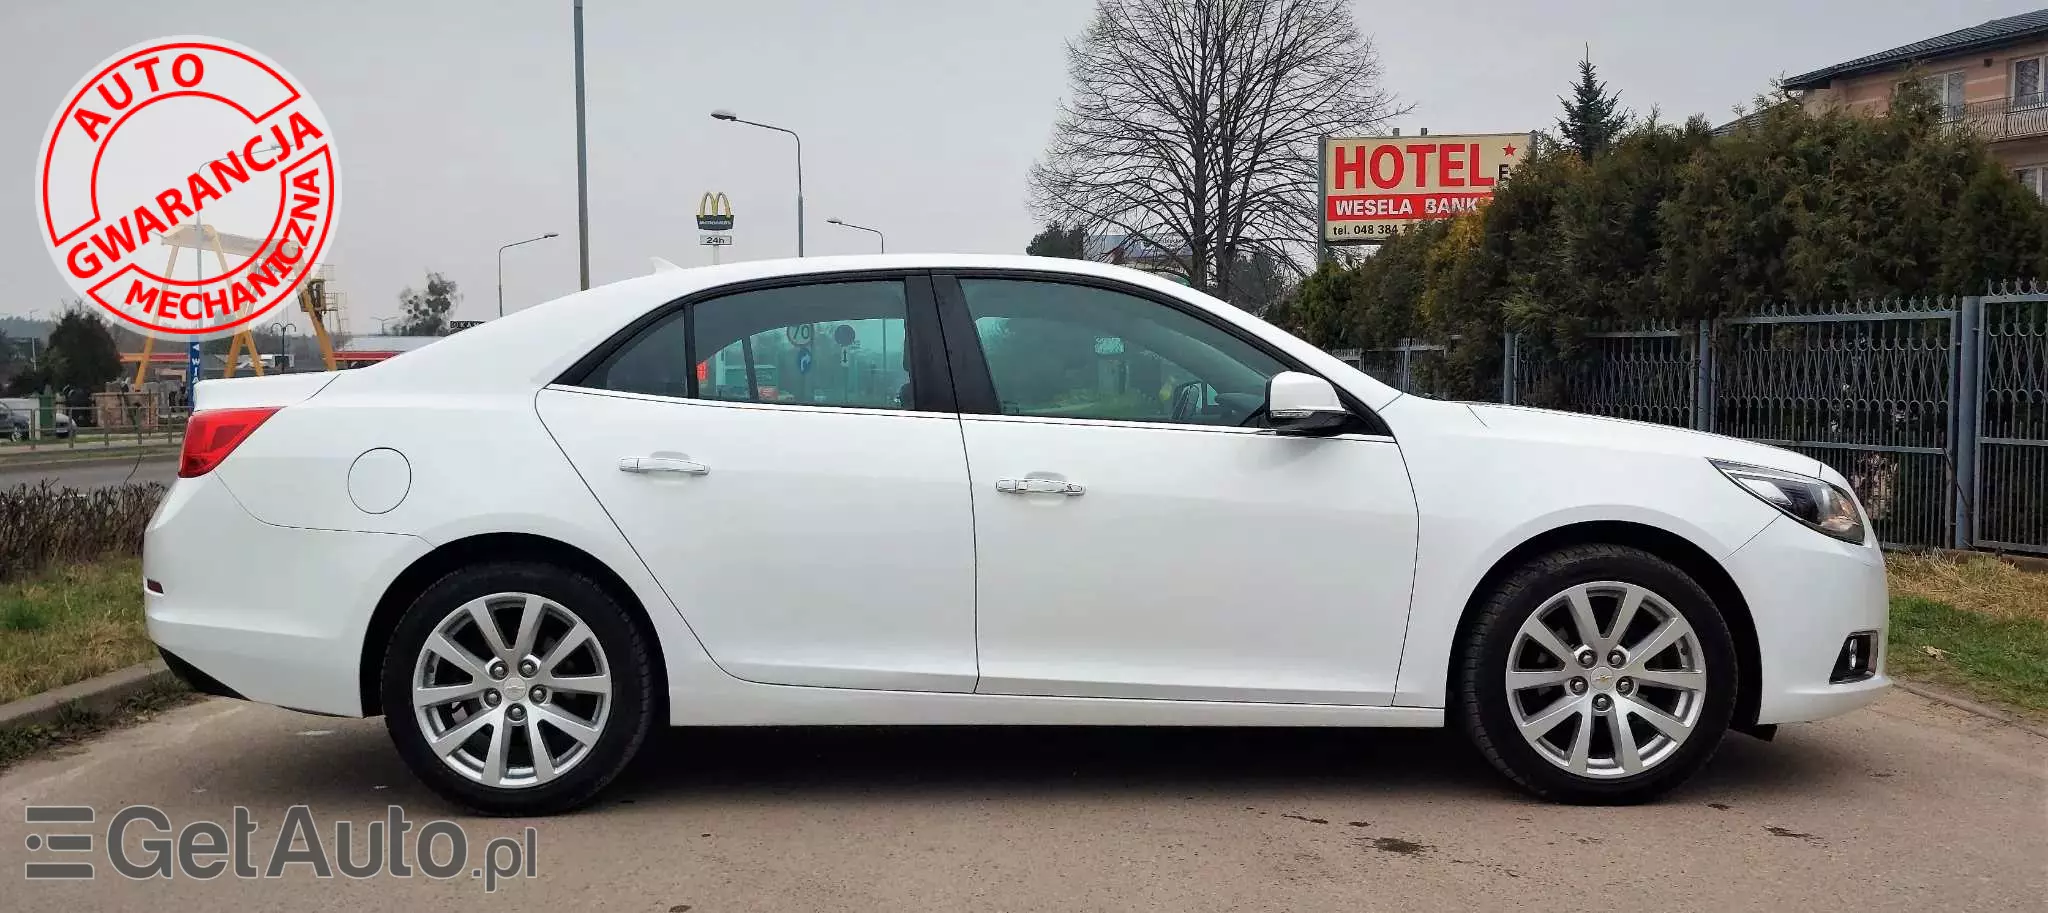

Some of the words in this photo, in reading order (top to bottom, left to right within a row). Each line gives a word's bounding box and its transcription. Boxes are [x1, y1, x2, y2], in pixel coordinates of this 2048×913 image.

[1334, 143, 1495, 190] HOTEL
[1335, 197, 1413, 216] WESELA
[1424, 196, 1484, 214] BANK
[1333, 225, 1350, 236] tel.
[1353, 224, 1374, 235] 048
[1377, 224, 1399, 235] 384
[706, 236, 725, 244] 24h
